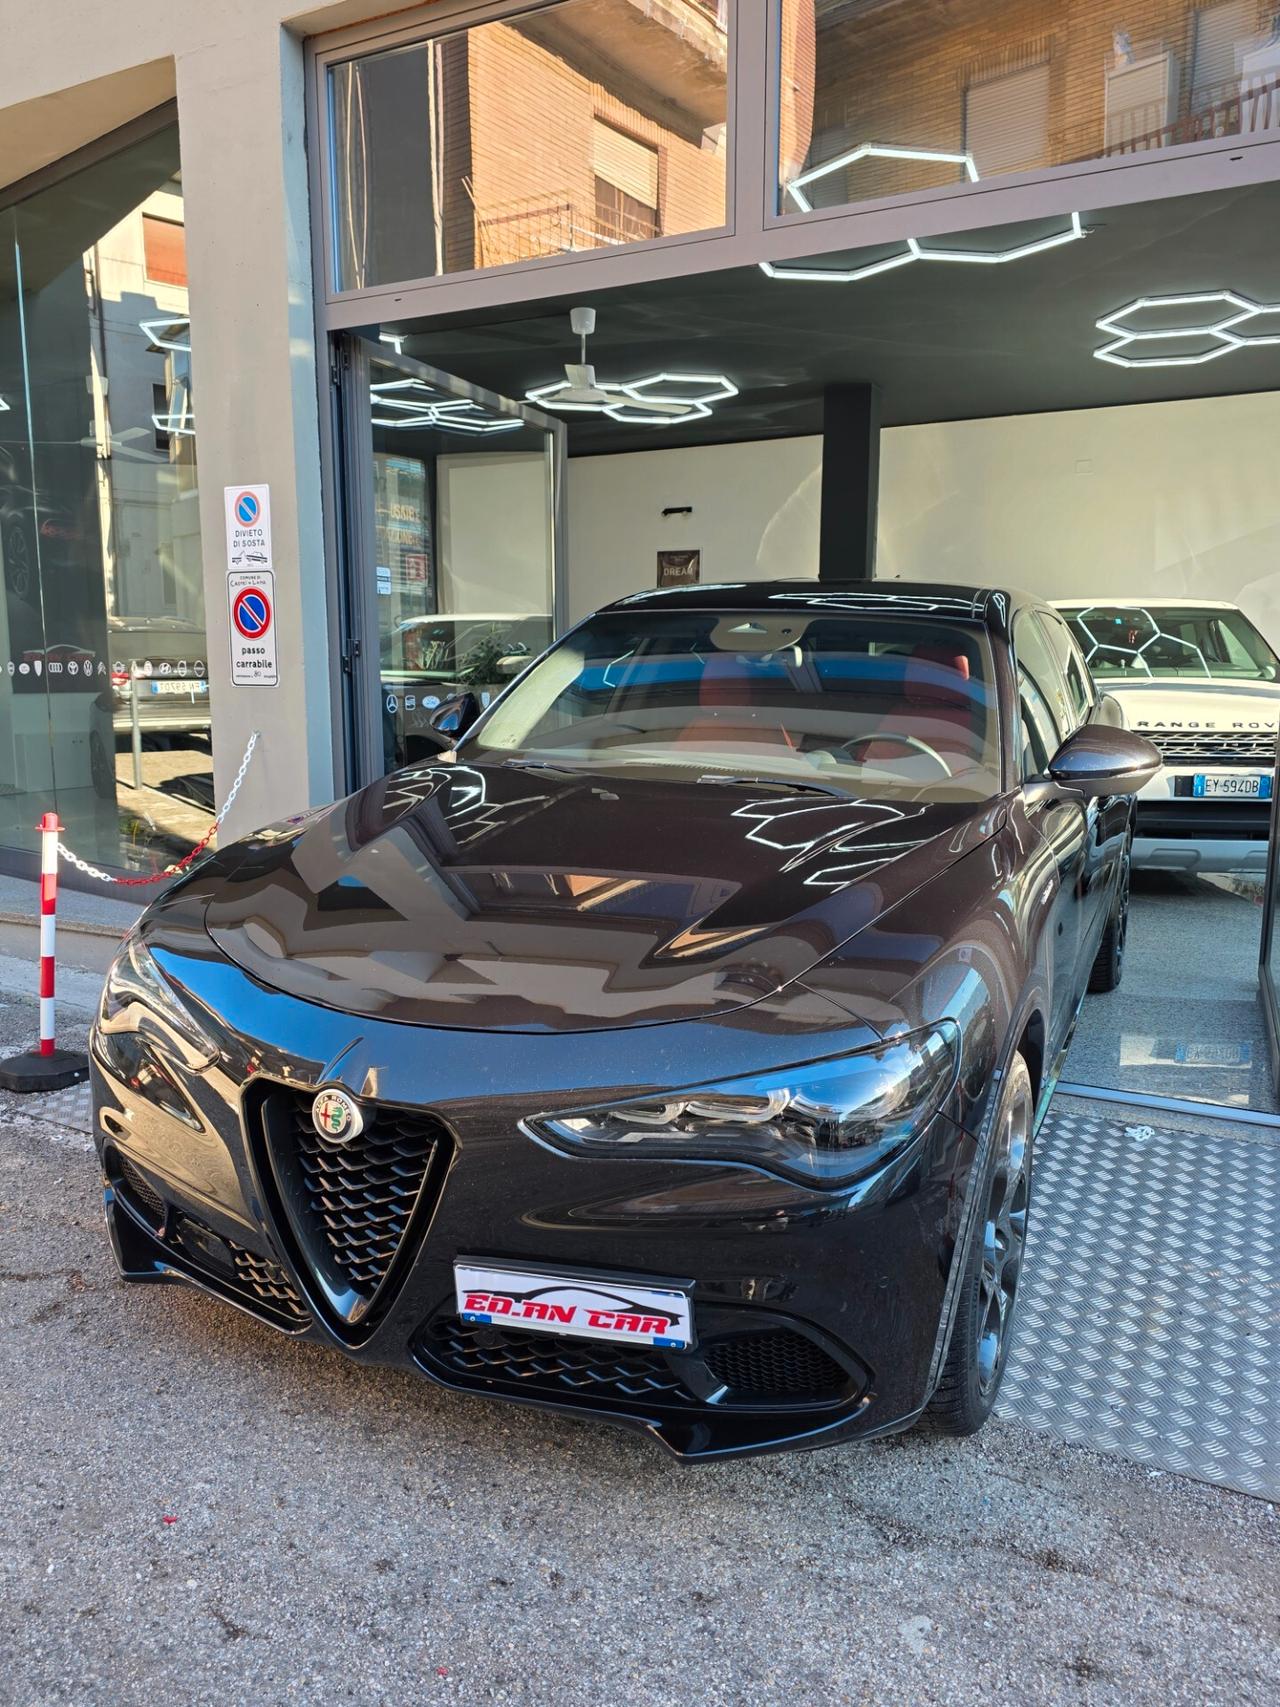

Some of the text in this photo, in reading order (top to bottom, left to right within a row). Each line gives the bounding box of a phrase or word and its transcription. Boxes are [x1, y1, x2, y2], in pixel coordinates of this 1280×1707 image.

[235, 529, 263, 538] DIVIETO
[242, 539, 265, 548] SOSTA
[241, 647, 265, 656] passo
[236, 659, 272, 668] carrabile
[1136, 721, 1216, 729] RANGE
[583, 1308, 671, 1335] CAR
